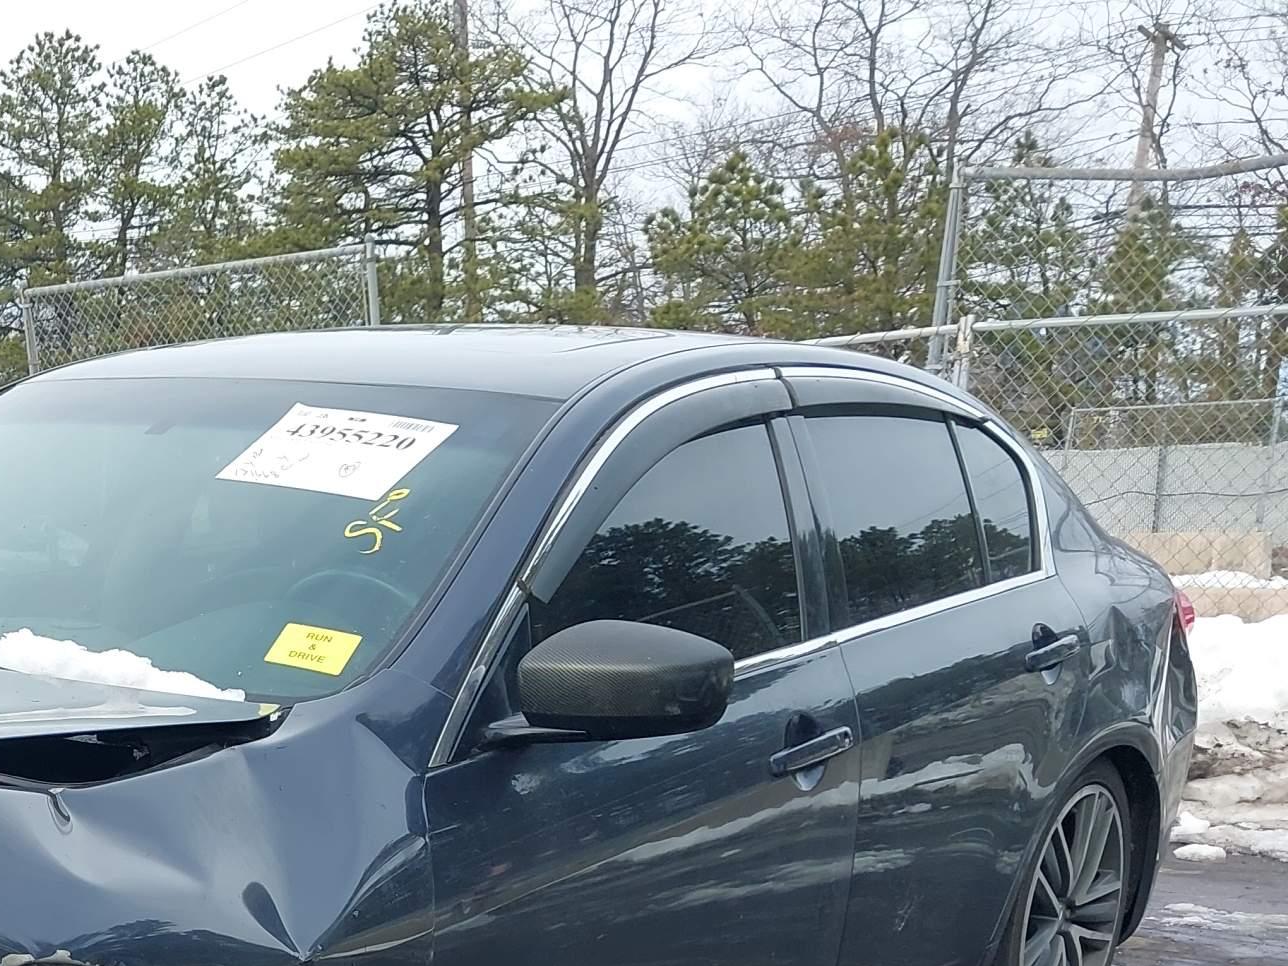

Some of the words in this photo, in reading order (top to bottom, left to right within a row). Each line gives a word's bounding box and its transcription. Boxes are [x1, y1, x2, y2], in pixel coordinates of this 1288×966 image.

[286, 422, 417, 451] 43955220
[306, 632, 333, 643] RUN
[308, 643, 316, 651] &
[288, 650, 327, 664] DRIVE
